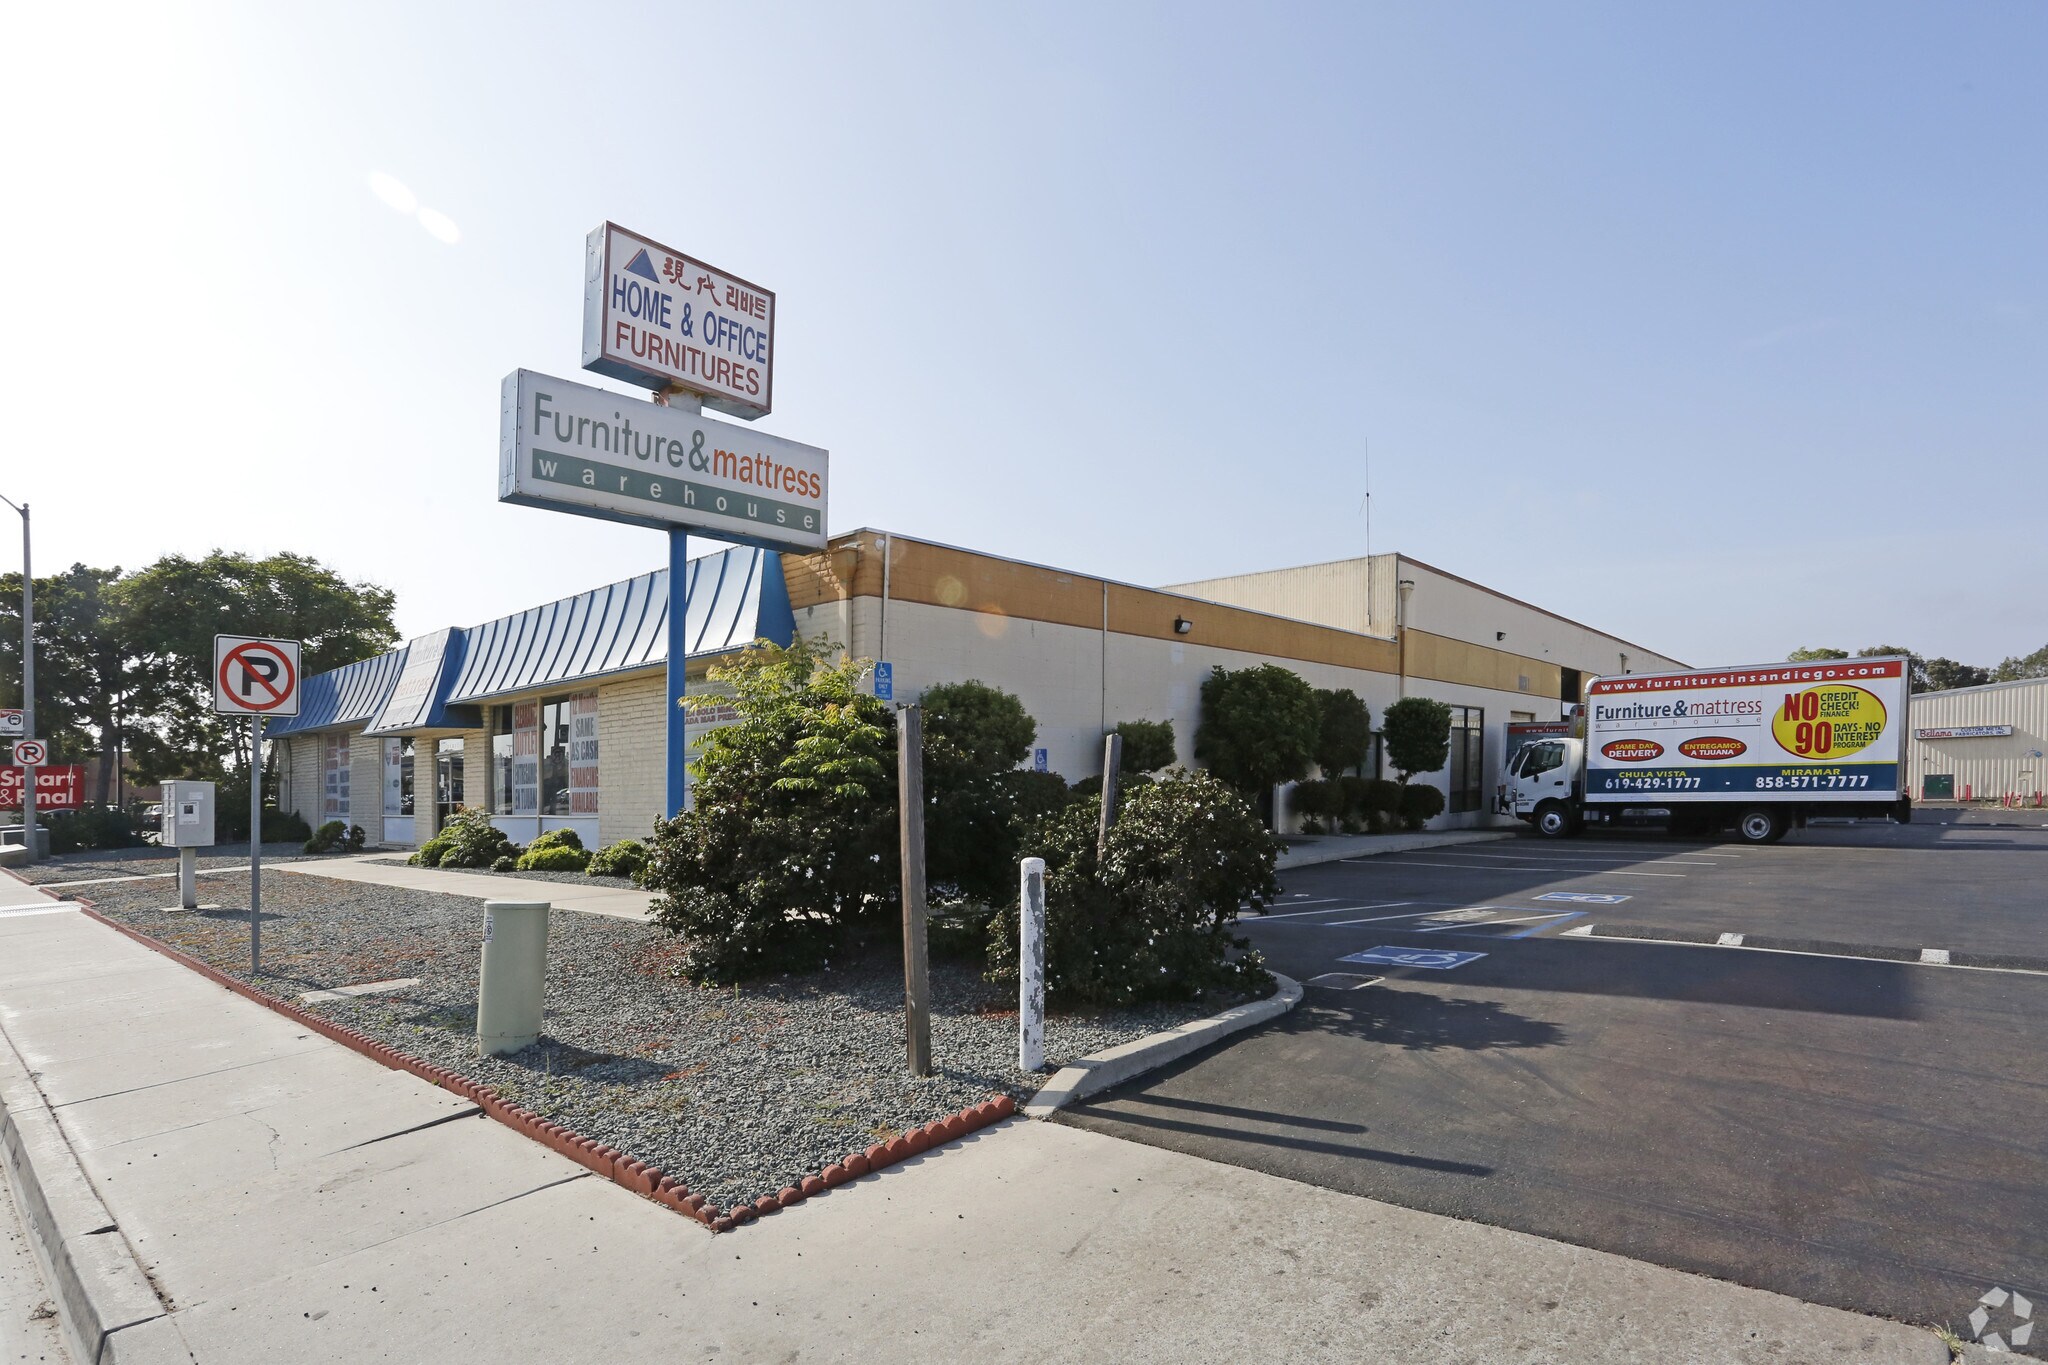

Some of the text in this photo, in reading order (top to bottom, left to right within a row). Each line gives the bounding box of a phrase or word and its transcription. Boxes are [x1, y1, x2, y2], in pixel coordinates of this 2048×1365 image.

[725, 285, 766, 321] 리바트
[612, 273, 767, 365] HOME & OFFICE
[615, 320, 760, 396] FURNITURES
[537, 457, 814, 530] warehouse
[1600, 665, 1886, 692] www.furnitureinsandiego.com
[1820, 691, 1859, 701] CREDIT
[1783, 691, 1819, 722] NO
[1820, 701, 1860, 711] CHECK!
[1820, 710, 1850, 718] FINANCE
[575, 717, 594, 738] SAME
[1595, 716, 1762, 729] warehouse
[1865, 721, 1881, 731] NO
[1794, 721, 1832, 755] 90
[1833, 732, 1881, 742] INTEREST
[1833, 741, 1866, 749] PROGRAM
[581, 739, 599, 760] CASH
[1608, 749, 1658, 758] DELIVERY
[1684, 742, 1742, 750] ENTREGAMOS
[1605, 777, 1701, 790] 619-429-1777
[1755, 775, 1869, 788] 858-571-7777
[16, 787, 74, 804] Fnal
